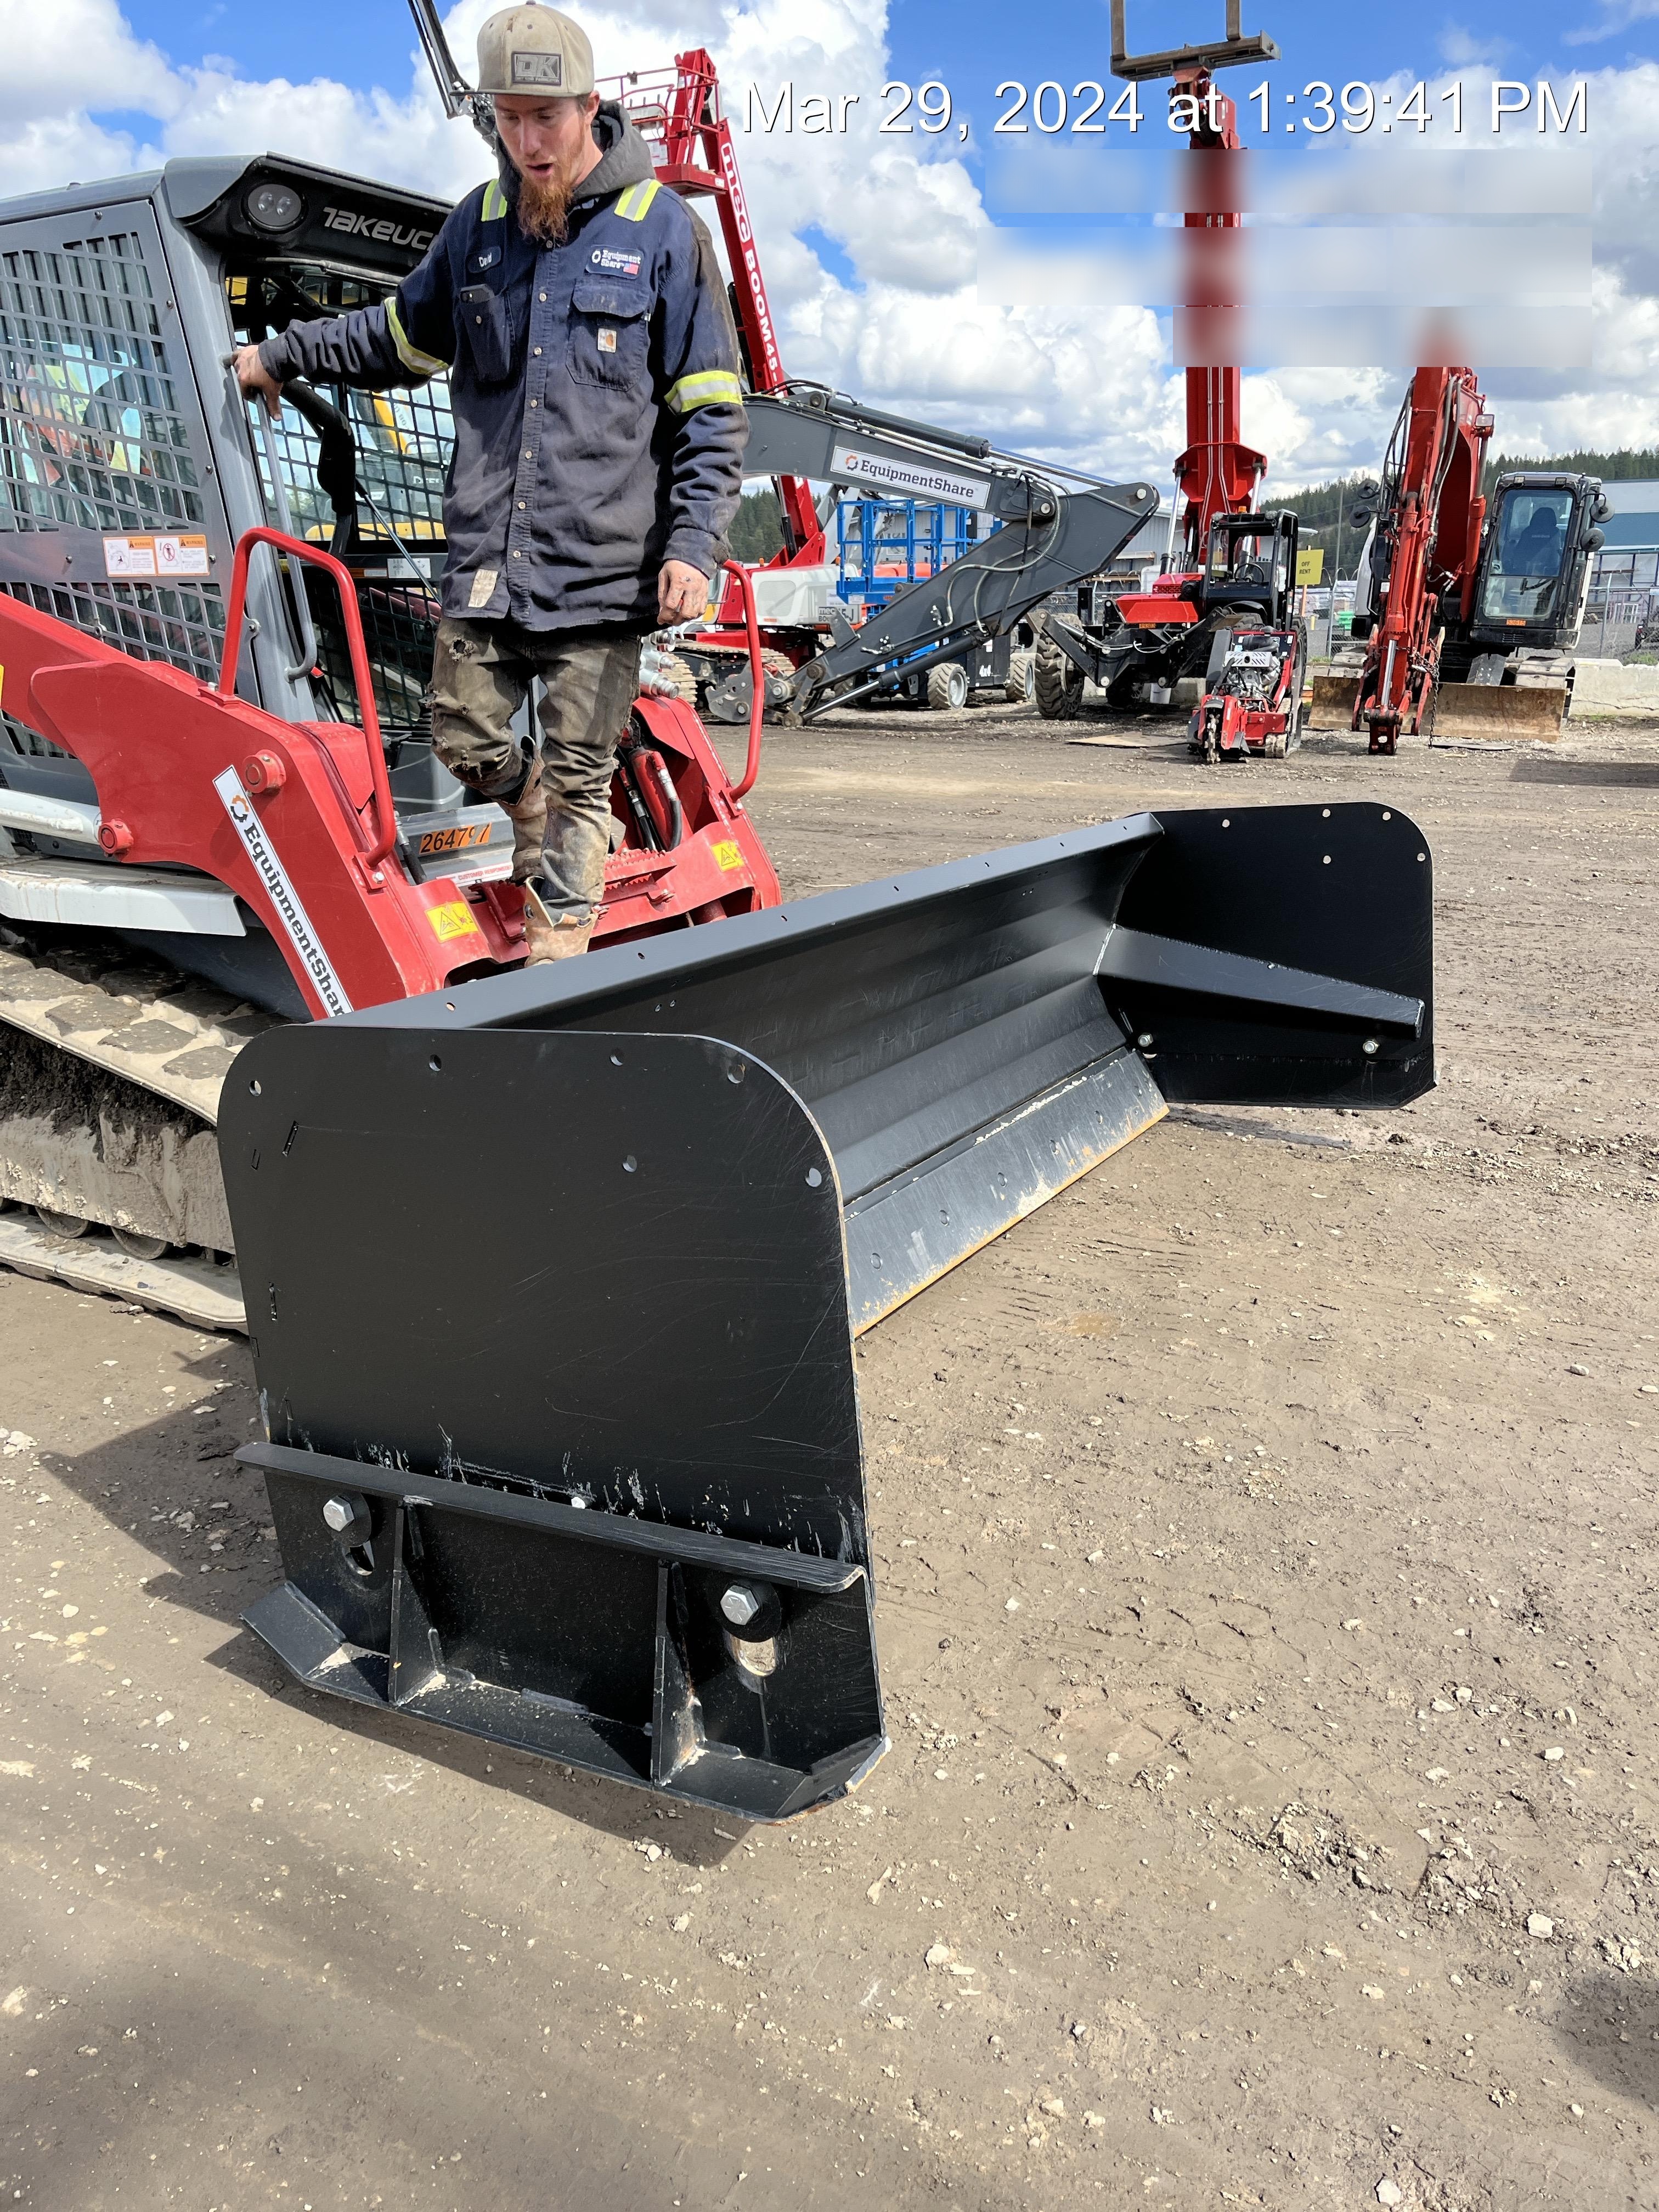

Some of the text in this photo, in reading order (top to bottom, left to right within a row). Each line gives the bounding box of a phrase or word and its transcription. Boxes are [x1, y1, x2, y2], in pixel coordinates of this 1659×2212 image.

[516, 56, 558, 77] DK
[323, 207, 439, 251] TAKEUC
[860, 459, 974, 498] EquipmentShare
[244, 822, 346, 1017] EquipmentShar
